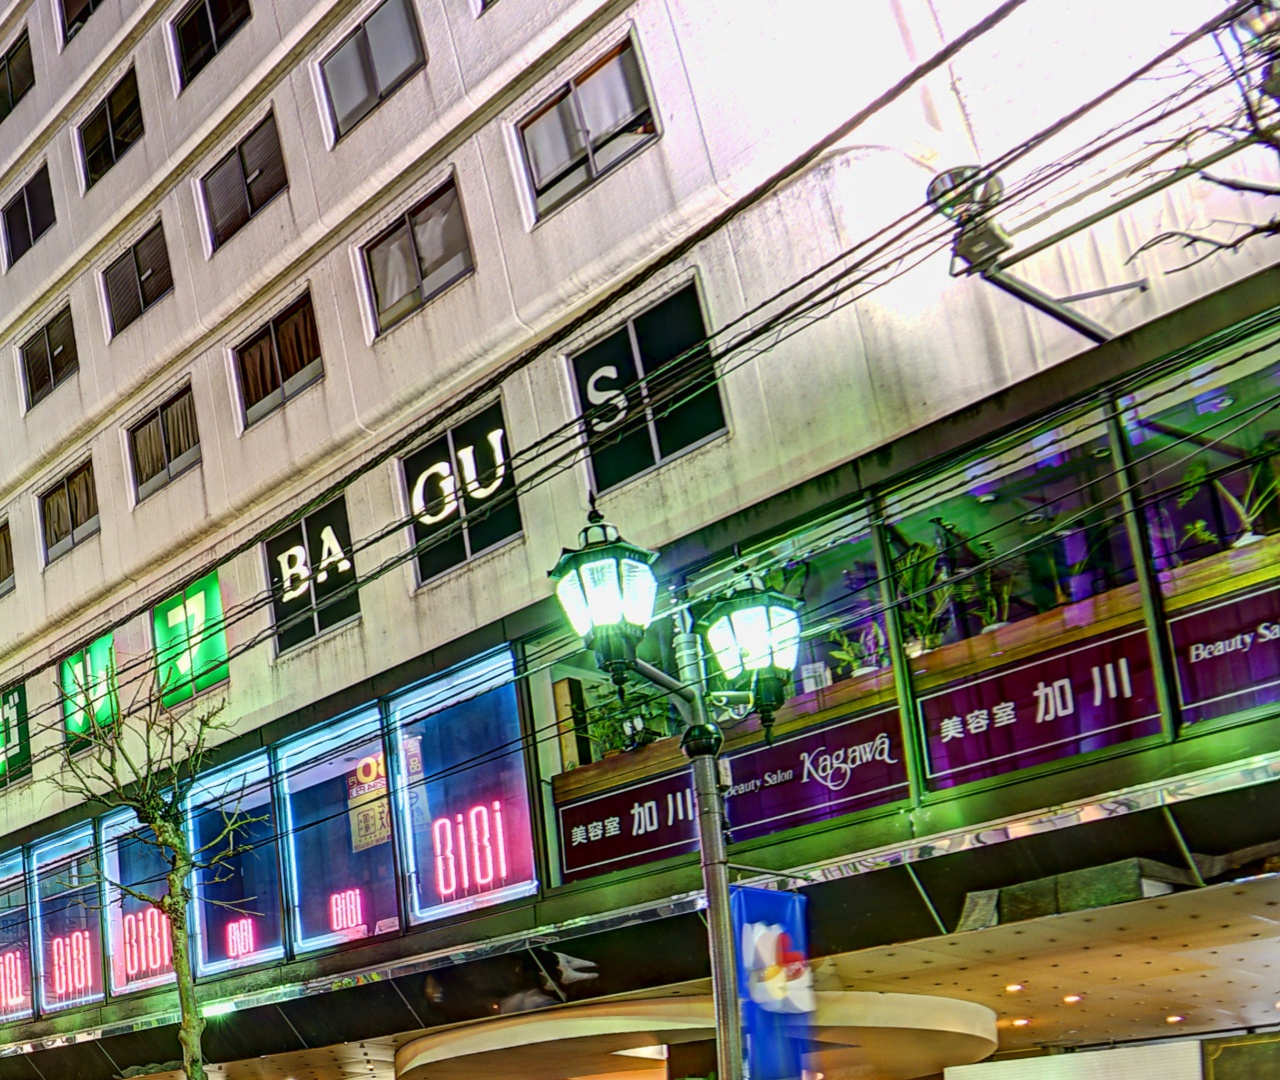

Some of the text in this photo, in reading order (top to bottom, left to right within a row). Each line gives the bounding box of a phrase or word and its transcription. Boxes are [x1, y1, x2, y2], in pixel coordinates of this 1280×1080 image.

[1190, 632, 1255, 664] Beauty
[940, 657, 1133, 743] 美容室 加川
[763, 769, 794, 787] Salon
[799, 733, 899, 791] Kagawa
[571, 787, 693, 847] 美容室 加川
